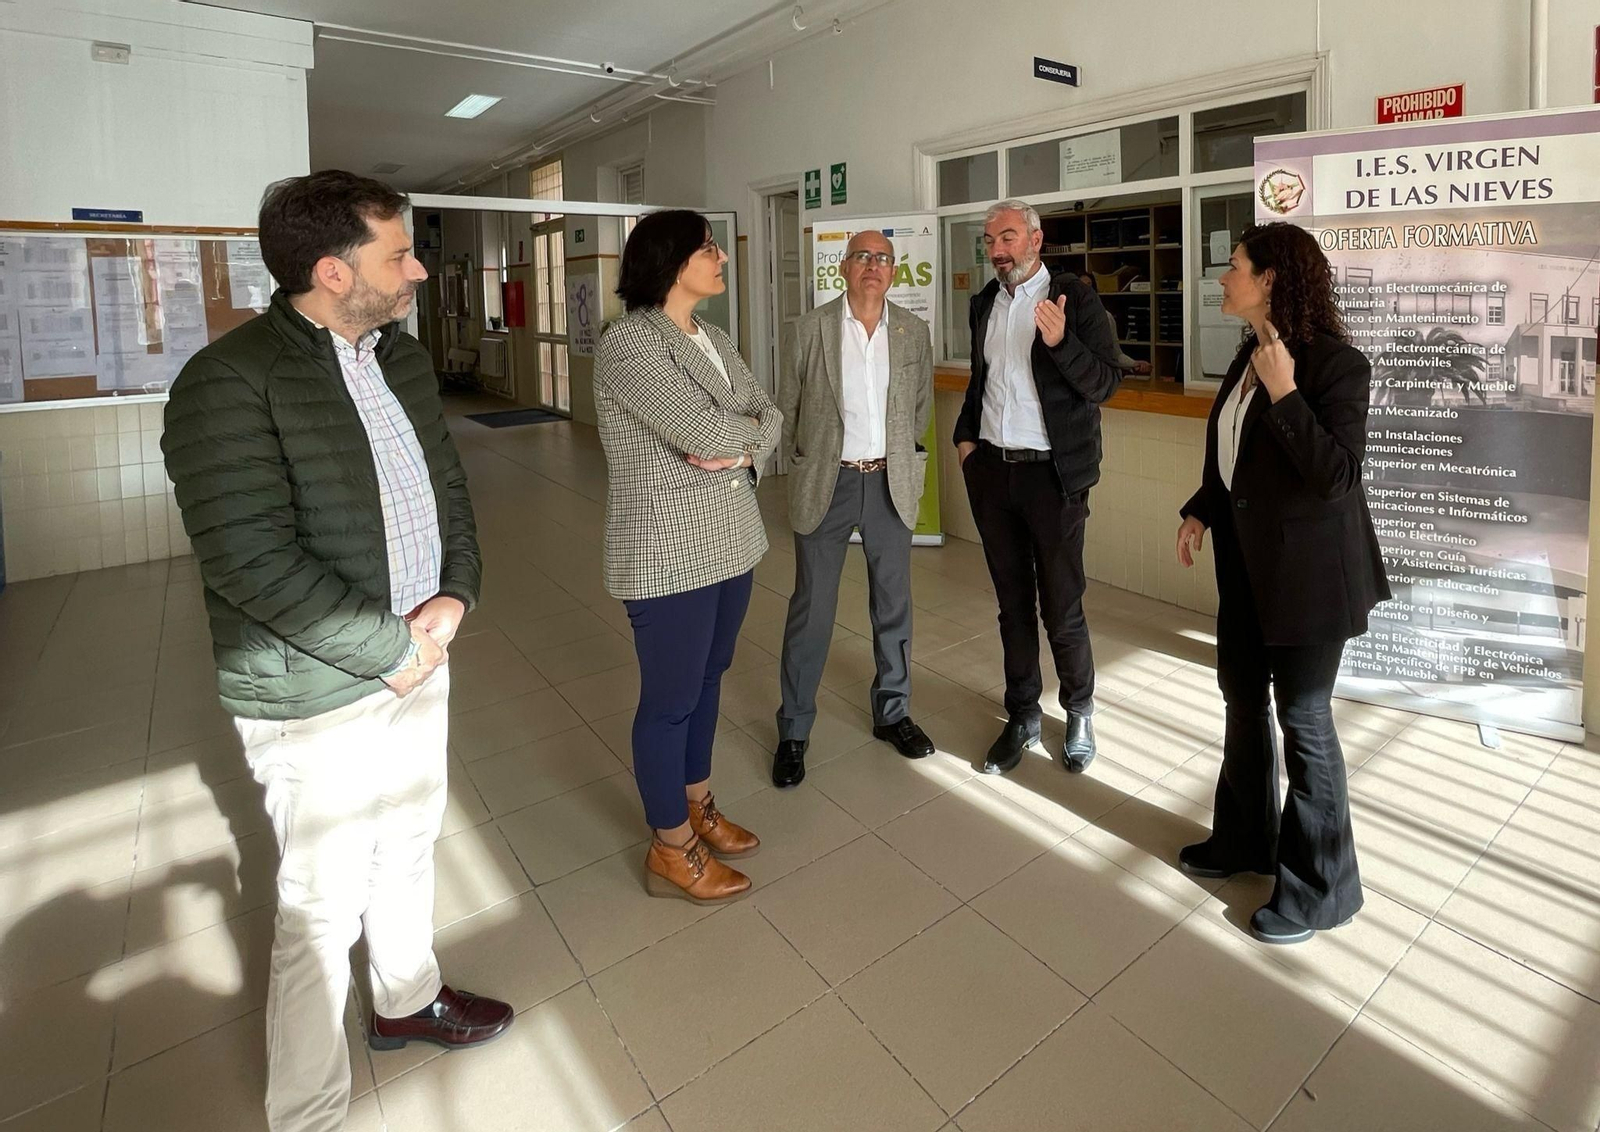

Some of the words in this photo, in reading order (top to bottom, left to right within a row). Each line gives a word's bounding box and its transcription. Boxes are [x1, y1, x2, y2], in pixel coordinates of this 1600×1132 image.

[1383, 88, 1457, 115] PROHIBIDO
[1356, 155, 1418, 177] I.E.S.
[1425, 145, 1540, 172] VIRGEN
[1346, 188, 1380, 209] DE
[1390, 185, 1438, 206] LAS
[1449, 178, 1553, 203] NIEVES
[1319, 227, 1397, 251] OFERTA
[1403, 220, 1538, 248] FORMATIVA
[817, 265, 839, 277] CO
[892, 253, 933, 287] ÁS
[833, 277, 846, 291] Q
[1333, 284, 1364, 294] cnico
[1368, 286, 1382, 294] en
[1386, 282, 1486, 294] Electromecánica
[1491, 281, 1507, 292] de
[1336, 297, 1385, 311] quinaria
[1340, 313, 1364, 323] nico
[1368, 315, 1382, 323] en
[1386, 312, 1479, 324] Mantenimiento
[1348, 326, 1416, 337] omecánico
[1368, 344, 1382, 353] en
[1386, 342, 1486, 355] Electromecánica
[1490, 344, 1506, 355] de
[1377, 356, 1452, 368] Automóviles
[1369, 379, 1382, 388] en
[1385, 377, 1453, 391] Carpintería
[1457, 382, 1464, 392] y
[1468, 380, 1516, 392] Mueble
[1368, 408, 1381, 416] en
[1385, 406, 1459, 419] Mecanizado
[1368, 430, 1382, 439] en
[1386, 429, 1463, 443] Instalaciones
[1365, 443, 1453, 457] omunicaciones
[1367, 457, 1417, 470] Superior
[1420, 462, 1435, 471] en
[1438, 462, 1517, 478] Mecatrónica
[1367, 486, 1417, 499] Superior
[1420, 492, 1435, 501] en
[1438, 491, 1491, 507] Sistemas
[1494, 497, 1510, 508] de
[1367, 500, 1435, 514] unicaciones
[1438, 507, 1446, 515] e
[1449, 506, 1528, 523] Informáticos
[1419, 522, 1434, 531] en
[1374, 526, 1406, 538] iento
[1409, 530, 1477, 547] Electrónico
[1380, 545, 1416, 557] perior
[1419, 551, 1434, 559] en
[1437, 550, 1466, 563] Guía
[1392, 558, 1399, 567] y
[1401, 557, 1466, 574] Asistencias
[1469, 565, 1526, 581] Turísticas
[1419, 578, 1433, 587] en
[1437, 578, 1499, 596] Educación
[1368, 609, 1409, 621] miento
[1375, 600, 1415, 612] perior
[1419, 605, 1433, 615] en
[1437, 605, 1478, 622] Diseño
[1482, 614, 1489, 624] y
[1375, 632, 1388, 640] en
[1392, 633, 1460, 652] Electricidad
[1463, 644, 1471, 655] y
[1474, 645, 1543, 665] Electrónica
[1341, 657, 1382, 672] pintería
[1385, 666, 1392, 675] y
[1395, 667, 1438, 681] Mueble
[1375, 643, 1388, 651] en
[1392, 644, 1480, 666] Mantenimiento
[1483, 657, 1498, 669] de
[1500, 661, 1562, 680] Vehículos
[1376, 652, 1432, 669] Específico
[1435, 661, 1449, 673] de
[1453, 664, 1476, 677] FPB
[1479, 670, 1494, 680] en
